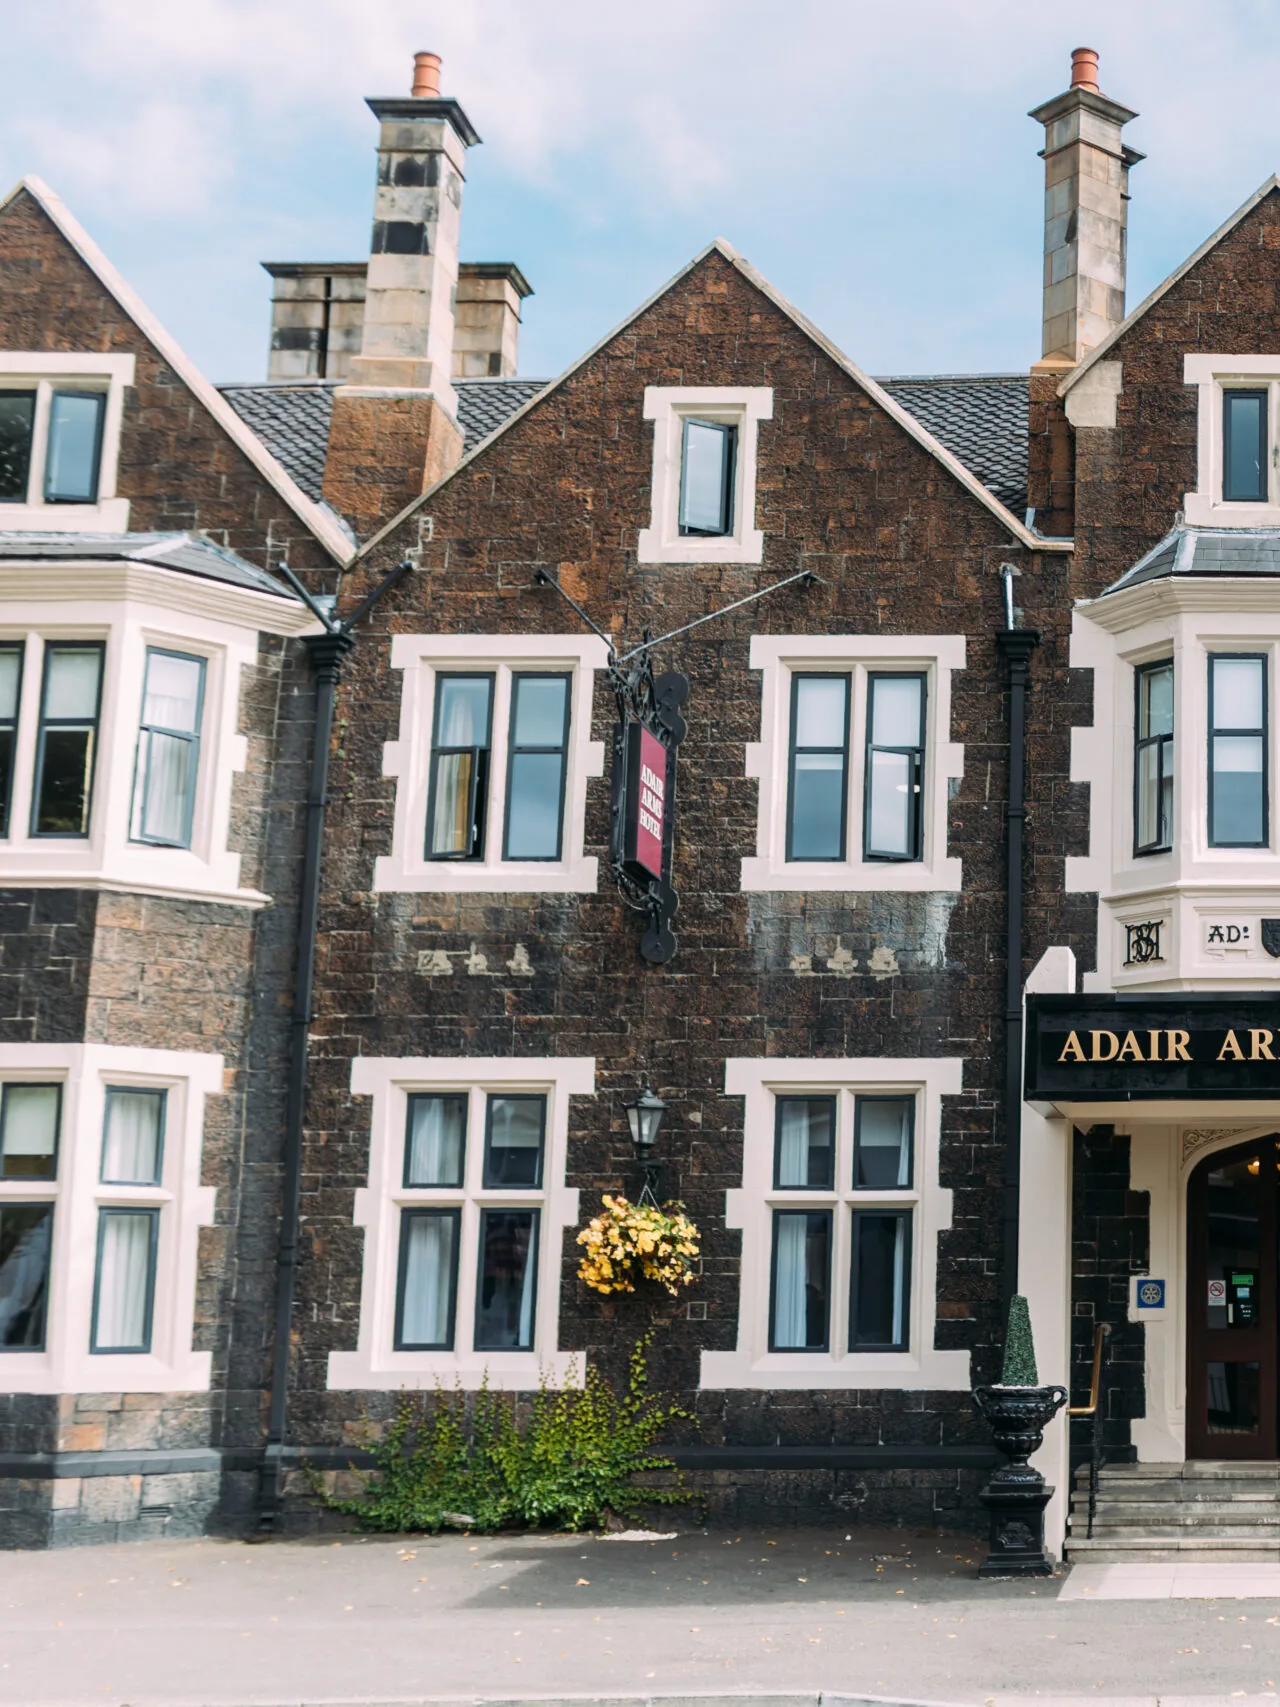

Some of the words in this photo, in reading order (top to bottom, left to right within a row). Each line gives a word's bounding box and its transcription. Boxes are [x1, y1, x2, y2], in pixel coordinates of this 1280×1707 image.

[641, 764, 664, 800] ADAIR
[641, 787, 662, 819] ARMS
[640, 807, 661, 840] HOTEL
[1058, 1029, 1193, 1061] ADAIR
